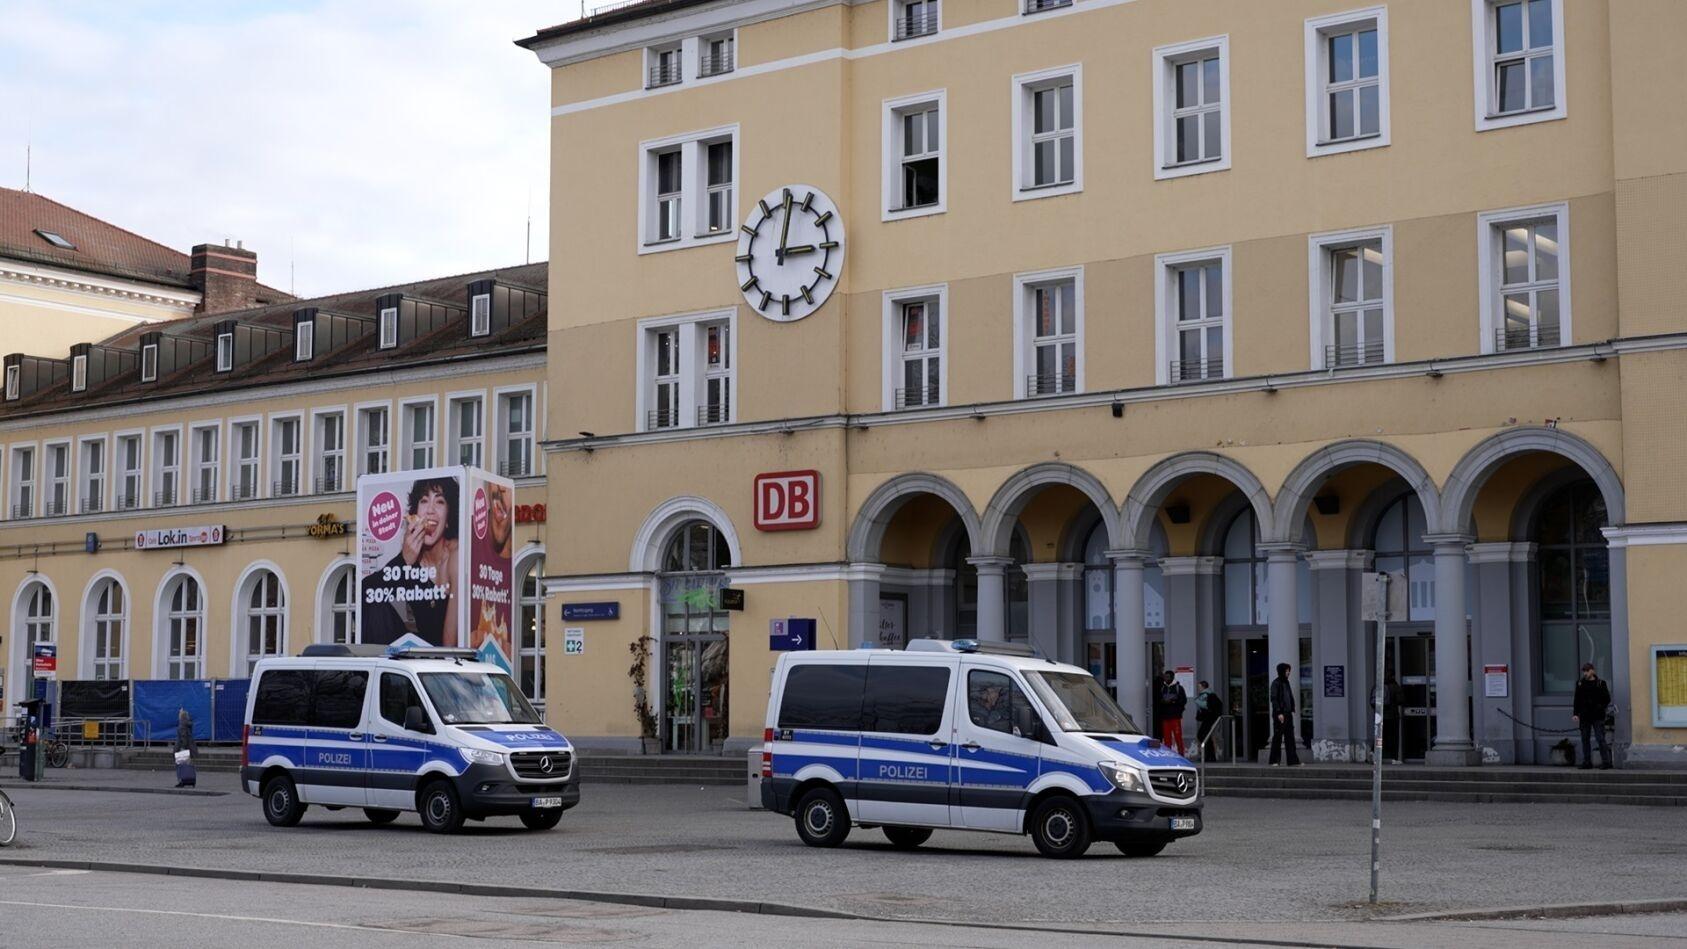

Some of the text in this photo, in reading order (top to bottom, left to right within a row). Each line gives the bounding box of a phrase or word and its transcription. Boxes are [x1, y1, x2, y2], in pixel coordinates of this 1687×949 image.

[763, 480, 809, 520] DB
[372, 500, 394, 517] Neu
[371, 520, 379, 528] in
[378, 522, 396, 535] Stadt
[158, 529, 187, 545] Lok.in
[383, 565, 437, 583] 30 Tage
[479, 564, 503, 585] 30 Tage
[366, 587, 394, 603] 30%
[506, 733, 555, 741] POLIZEI
[318, 752, 352, 765] POLIZEI
[880, 765, 927, 779] POLIZEI
